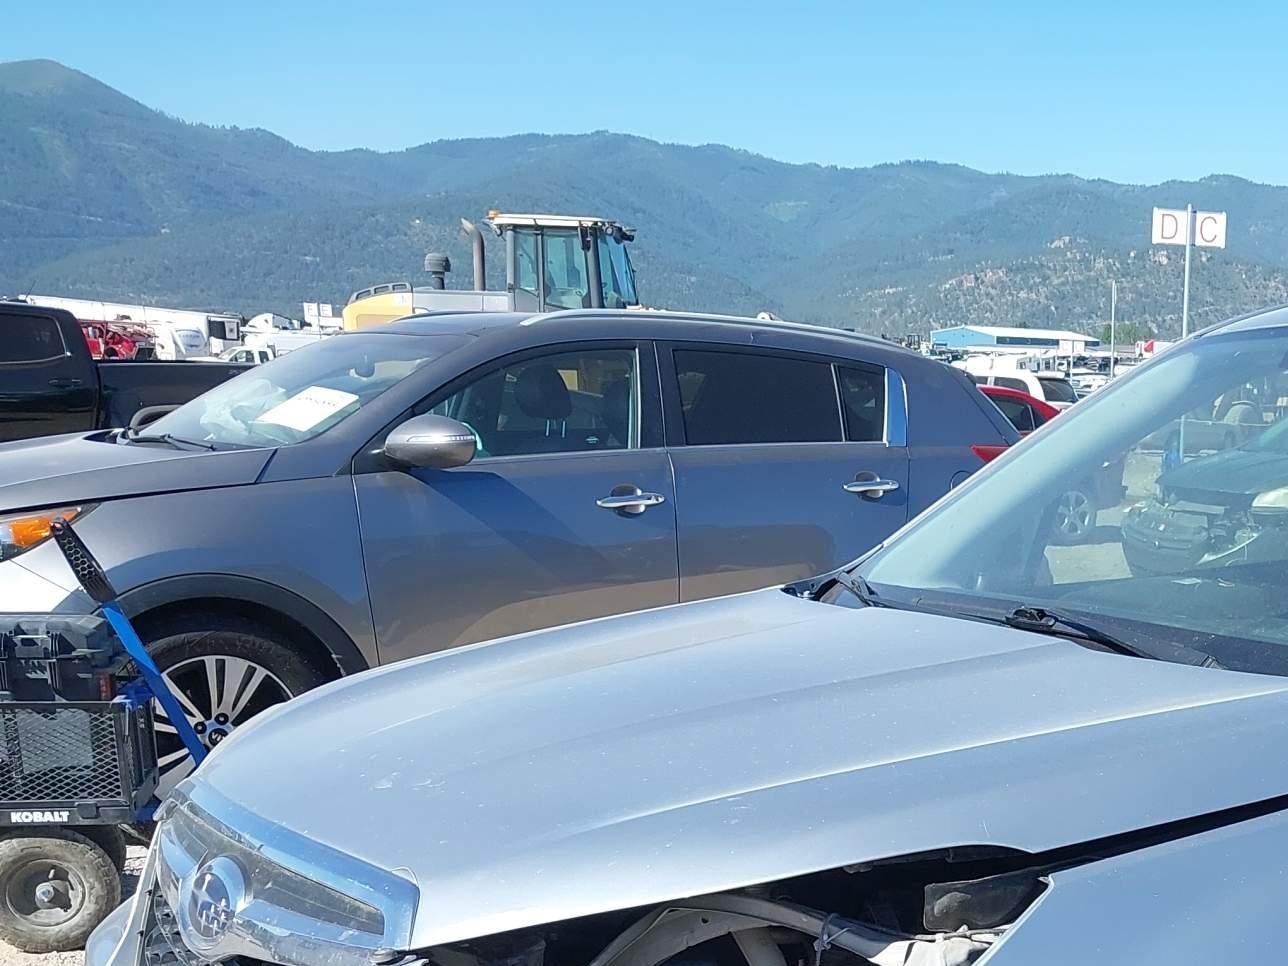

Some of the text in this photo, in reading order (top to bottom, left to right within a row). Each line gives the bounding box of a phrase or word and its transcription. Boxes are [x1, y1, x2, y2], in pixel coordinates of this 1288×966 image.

[1161, 213, 1178, 240] D
[1200, 216, 1217, 243] C
[10, 811, 70, 823] KOBALT
